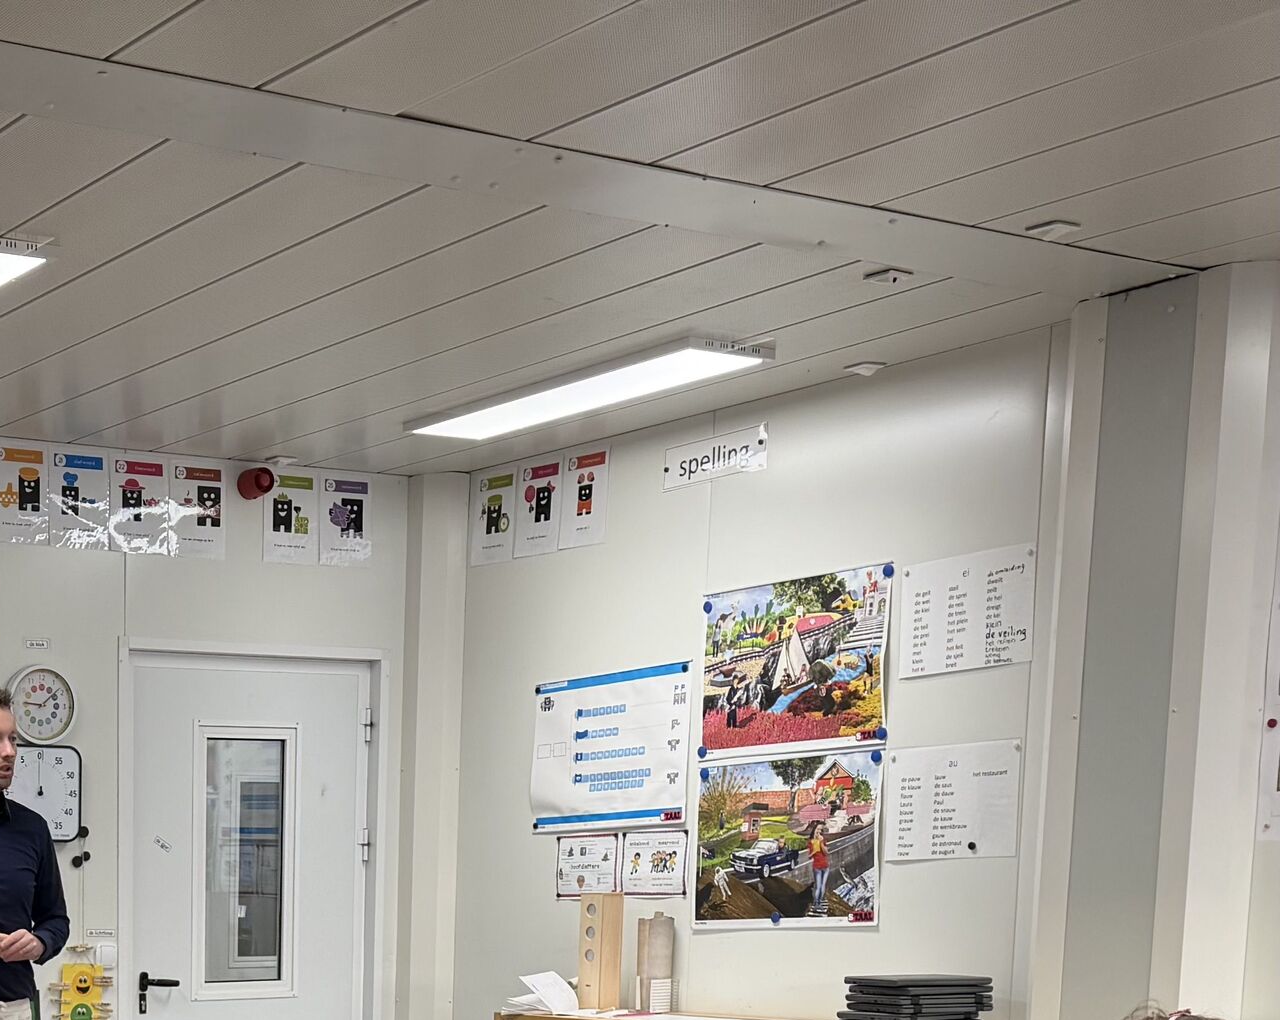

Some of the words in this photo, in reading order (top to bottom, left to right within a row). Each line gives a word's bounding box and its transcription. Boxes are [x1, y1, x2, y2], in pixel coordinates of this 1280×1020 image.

[679, 445, 750, 480] spelling
[962, 568, 970, 578] ei
[985, 627, 996, 640] de
[998, 625, 1027, 642] veiling
[37, 752, 42, 760] 0
[948, 760, 959, 768] au
[981, 769, 1008, 777] restaurant
[907, 776, 921, 784] pauw
[68, 790, 77, 798] 45
[64, 808, 73, 816] 40
